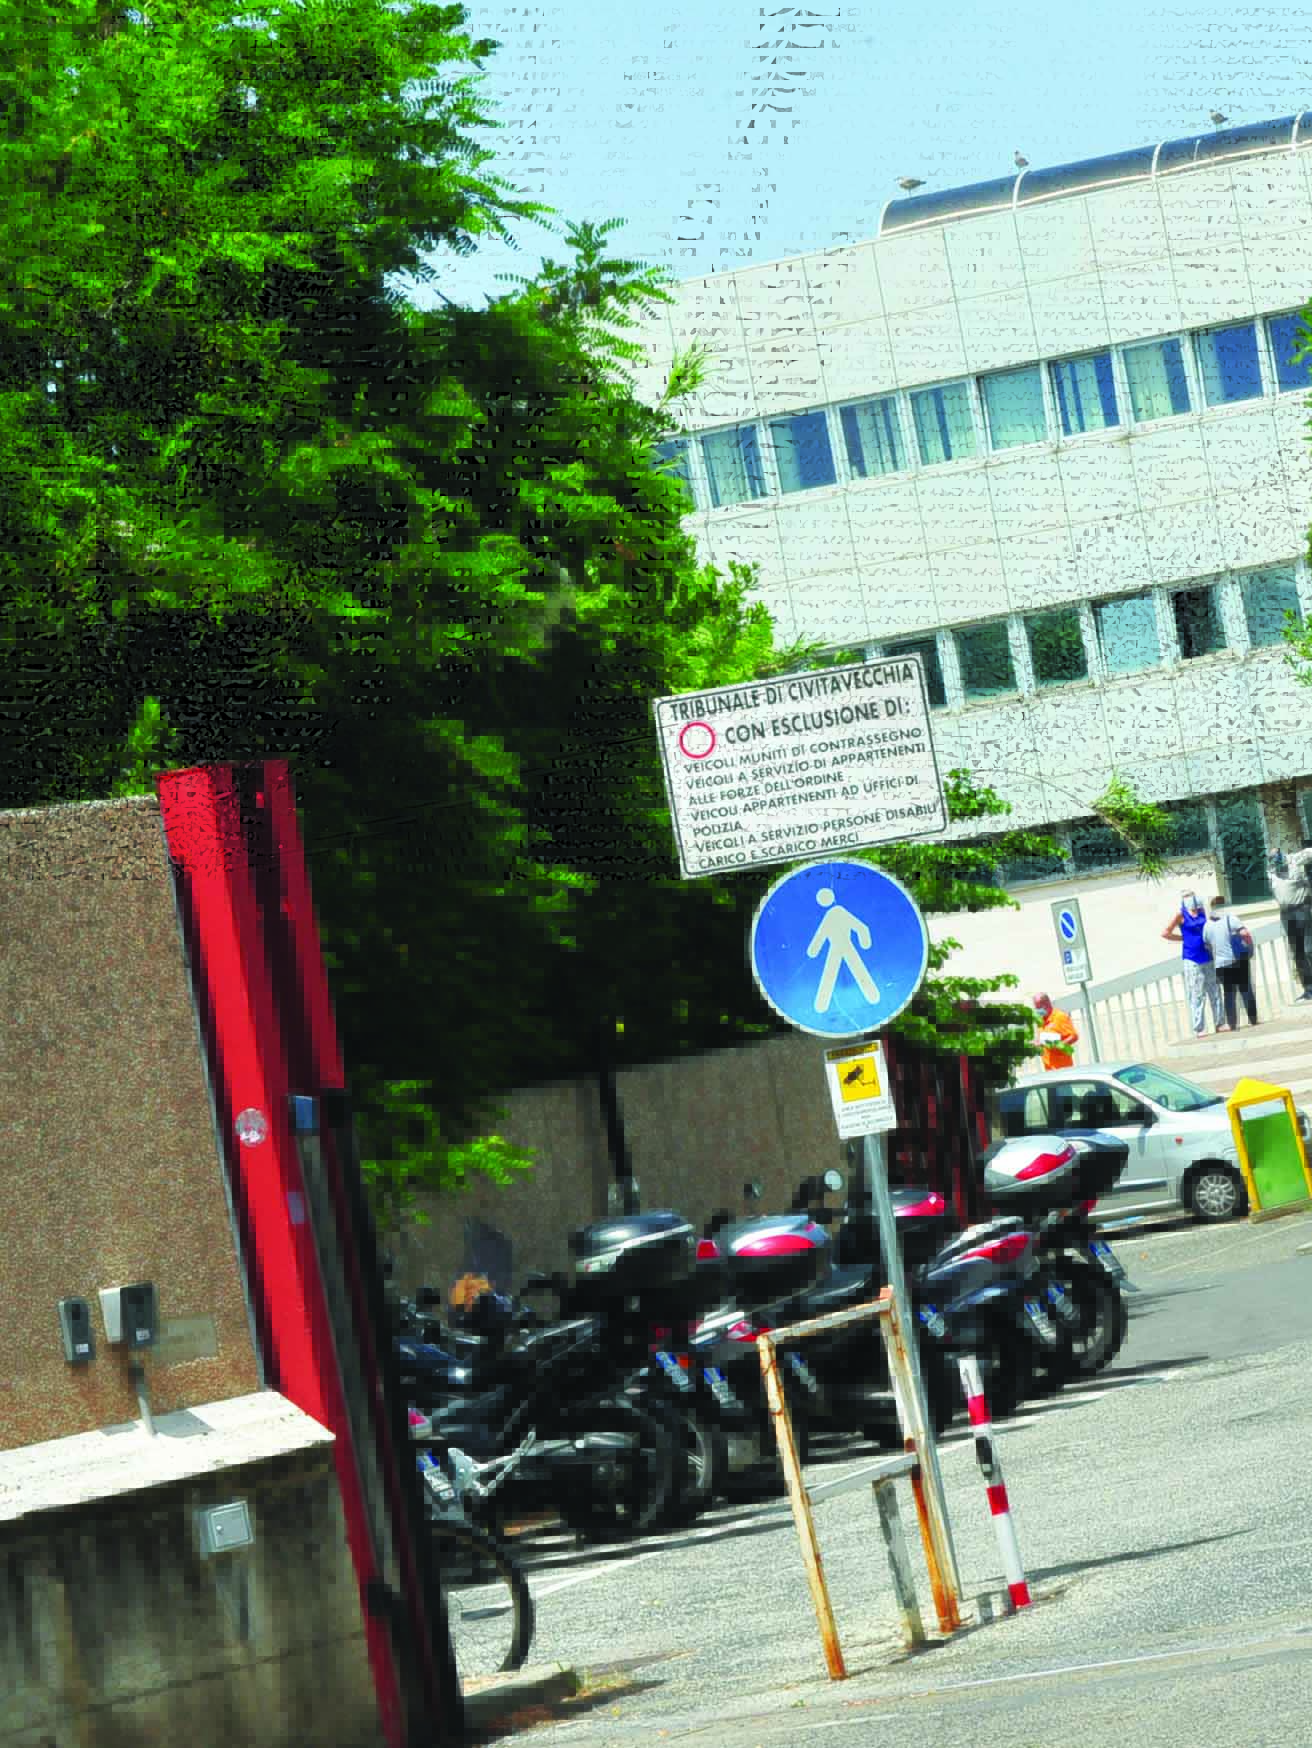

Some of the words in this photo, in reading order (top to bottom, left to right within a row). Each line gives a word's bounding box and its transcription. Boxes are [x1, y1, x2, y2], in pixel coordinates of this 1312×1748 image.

[670, 690, 760, 721] TRIBUNALE
[766, 687, 782, 705] DI
[789, 663, 914, 700] CIVITAVECCHIA
[725, 722, 765, 744] CON
[771, 702, 879, 736] ESCLUSIONE
[684, 758, 735, 774] VEICOLI
[740, 748, 787, 765] MUNITI
[791, 744, 805, 757] DI
[810, 728, 921, 754] CONTRASSEGNO
[686, 773, 734, 790] VEICOLI
[738, 771, 748, 782] A
[752, 760, 809, 780] SERVIZIO
[814, 758, 826, 769] DI
[832, 743, 926, 767] APPARTENENTI
[689, 792, 716, 806] ALLE
[720, 785, 760, 801] FORZE
[765, 771, 844, 794] DELL'ORDINE
[691, 804, 738, 821] VEICOLI
[743, 788, 836, 813] APPARTENENTI
[841, 784, 859, 797] AD
[863, 776, 901, 793] UFFICI
[905, 775, 918, 786] DI
[694, 820, 743, 837] POLIZIA
[695, 835, 745, 853] VEICOLI
[748, 833, 757, 845] A
[761, 823, 819, 842] SERVIZIO
[823, 811, 881, 831] PERSONE
[699, 852, 746, 869] CARICO
[751, 850, 759, 860] E
[762, 839, 817, 858] SCARICO
[821, 831, 860, 848] MERCI
